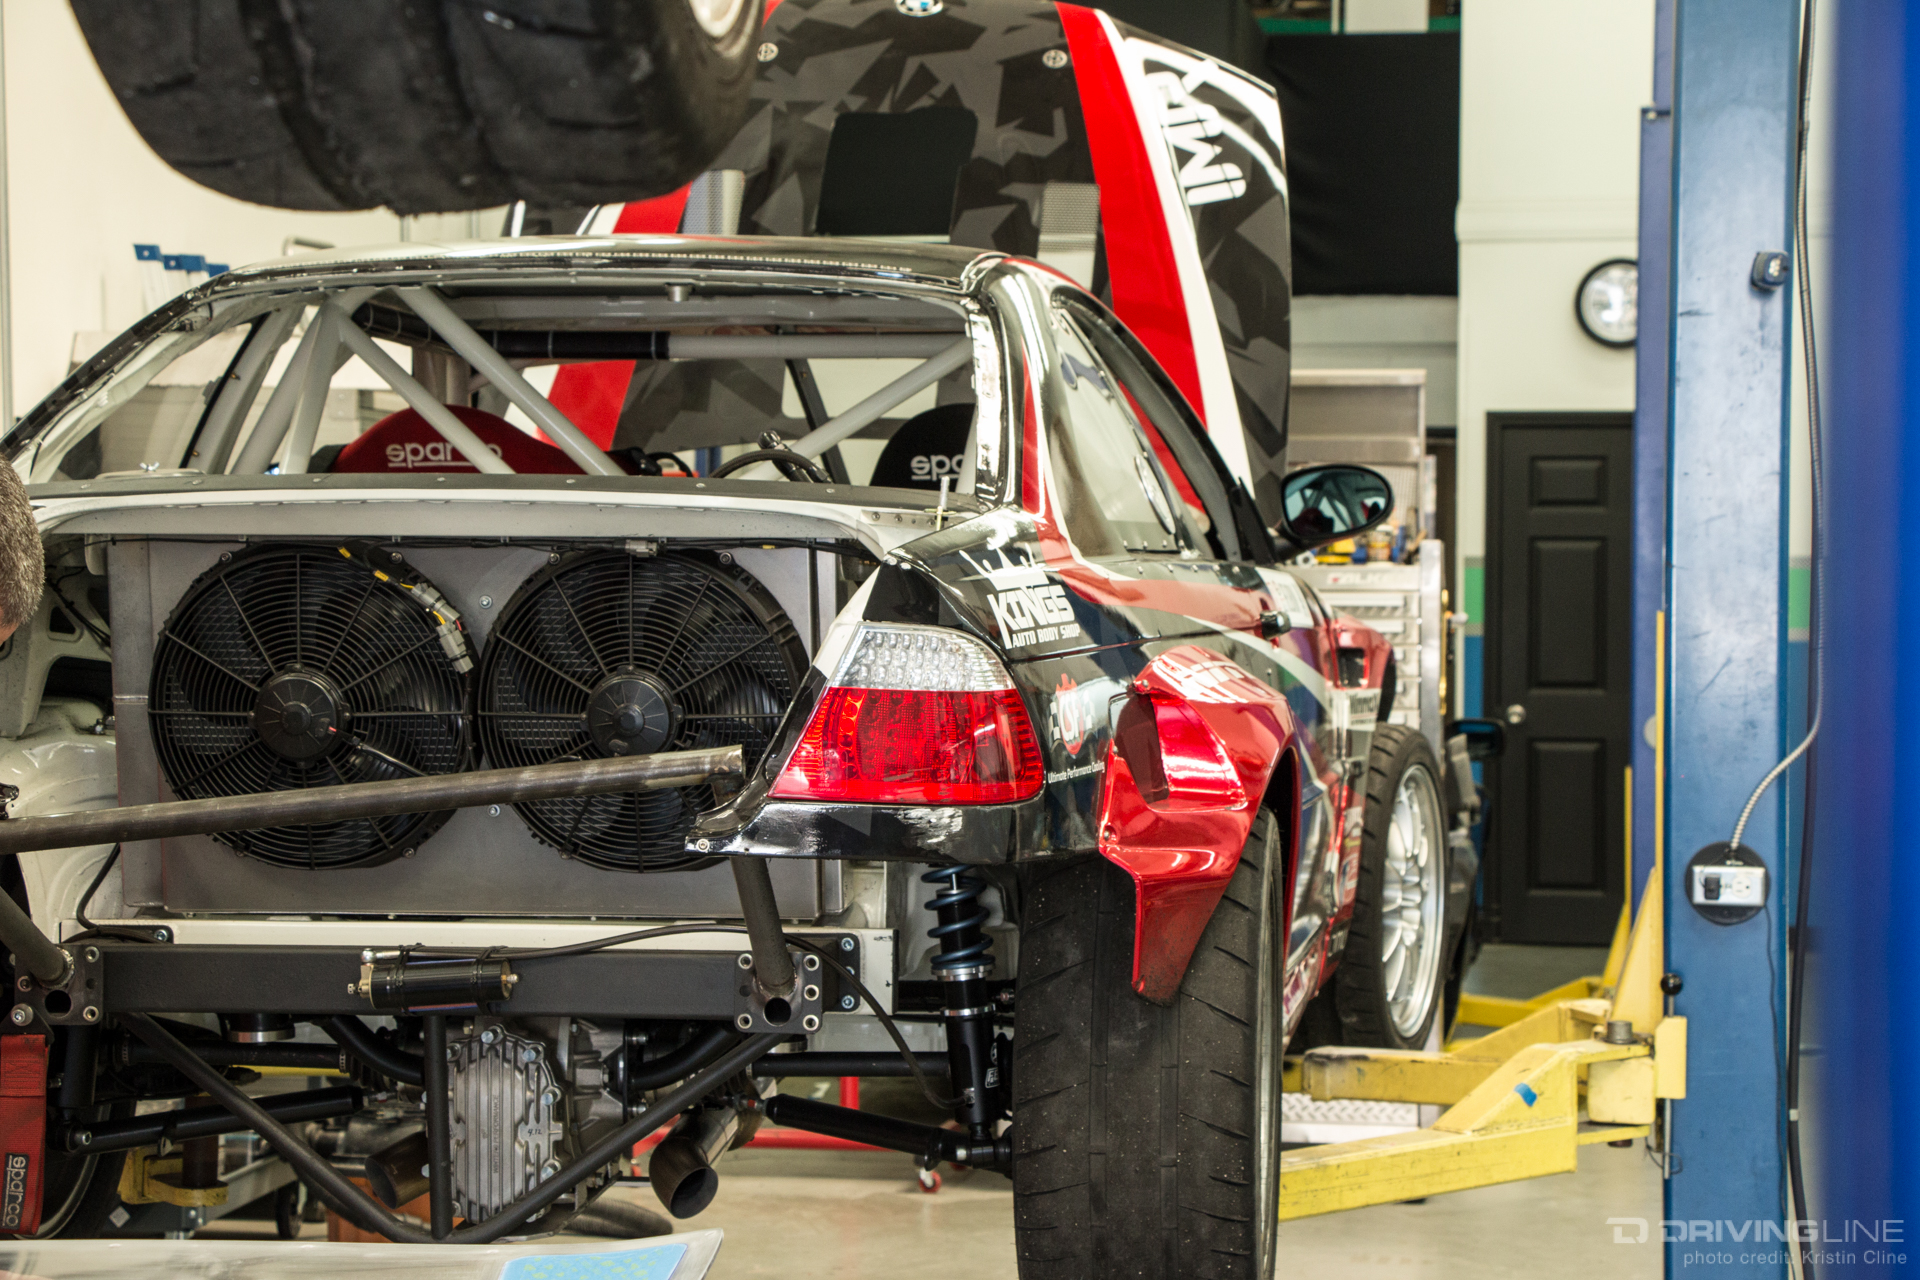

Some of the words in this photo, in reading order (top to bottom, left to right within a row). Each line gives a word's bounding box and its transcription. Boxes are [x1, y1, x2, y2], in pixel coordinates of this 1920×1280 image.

[385, 442, 503, 469] spar
[986, 584, 1076, 650] KINGS
[1012, 630, 1037, 648] AUTO
[1036, 626, 1060, 643] BODY
[1060, 623, 1081, 639] SHOP
[1048, 771, 1067, 784] Ultimate
[1066, 765, 1092, 779] Performance
[1091, 760, 1105, 773] Cooling
[6, 1156, 26, 1227] sparco
